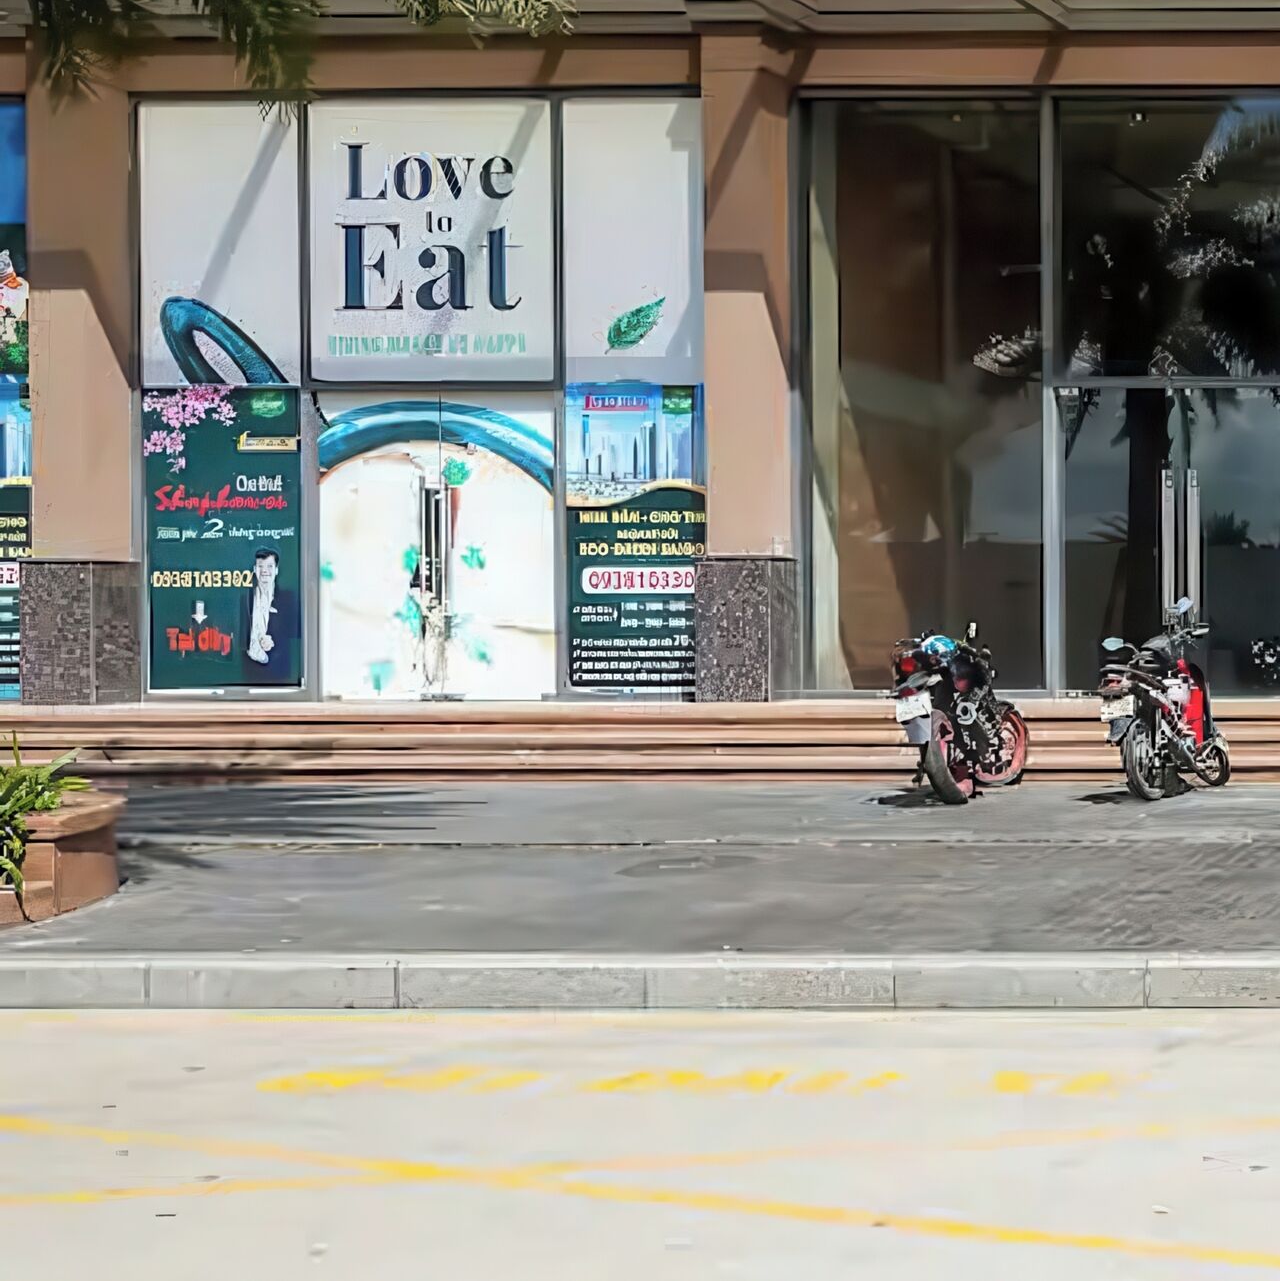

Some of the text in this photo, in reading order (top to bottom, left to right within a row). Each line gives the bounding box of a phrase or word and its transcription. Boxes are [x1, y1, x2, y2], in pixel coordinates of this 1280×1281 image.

[341, 141, 514, 201] Love
[426, 210, 453, 233] to
[335, 222, 523, 311] Eat
